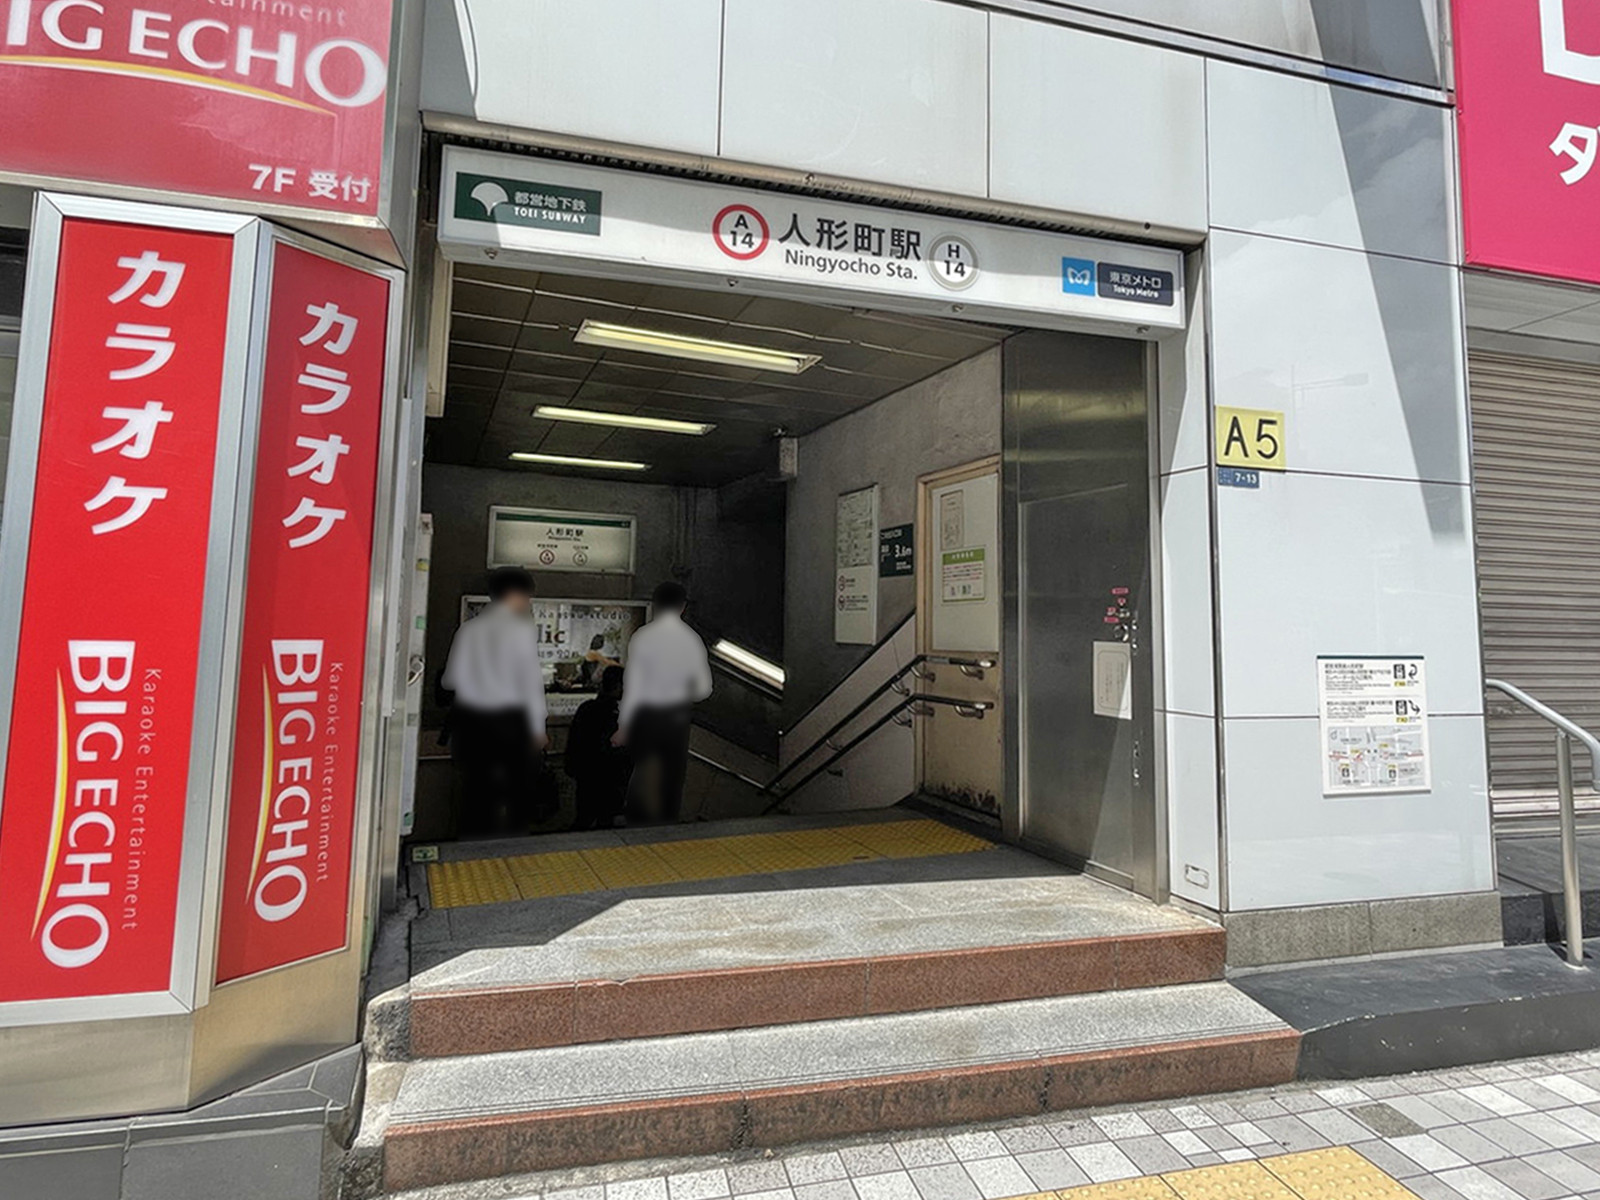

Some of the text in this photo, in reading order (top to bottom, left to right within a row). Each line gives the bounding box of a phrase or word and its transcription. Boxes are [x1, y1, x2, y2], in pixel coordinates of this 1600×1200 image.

[128, 8, 387, 108] ECHO
[248, 163, 371, 203] 7F 受付
[514, 206, 587, 224] TOEI SUBWAY
[734, 213, 750, 230] A
[730, 230, 755, 249] 14
[778, 213, 922, 262] 人形町駅
[947, 244, 960, 259] H
[785, 249, 918, 280] Ningyocho Sta.
[943, 260, 967, 278] 14
[1109, 271, 1162, 289] 東京メトロ
[1113, 284, 1160, 298] Tokyo Metro
[84, 250, 187, 535] カラオケ
[282, 302, 359, 548] カラオケ
[1223, 415, 1279, 460] A5
[254, 639, 324, 923] BIG ECHO
[315, 662, 344, 883] Karaoke Entertainment
[41, 640, 136, 968] BIG ECHO
[121, 667, 162, 931] Karaoke Entertainment
